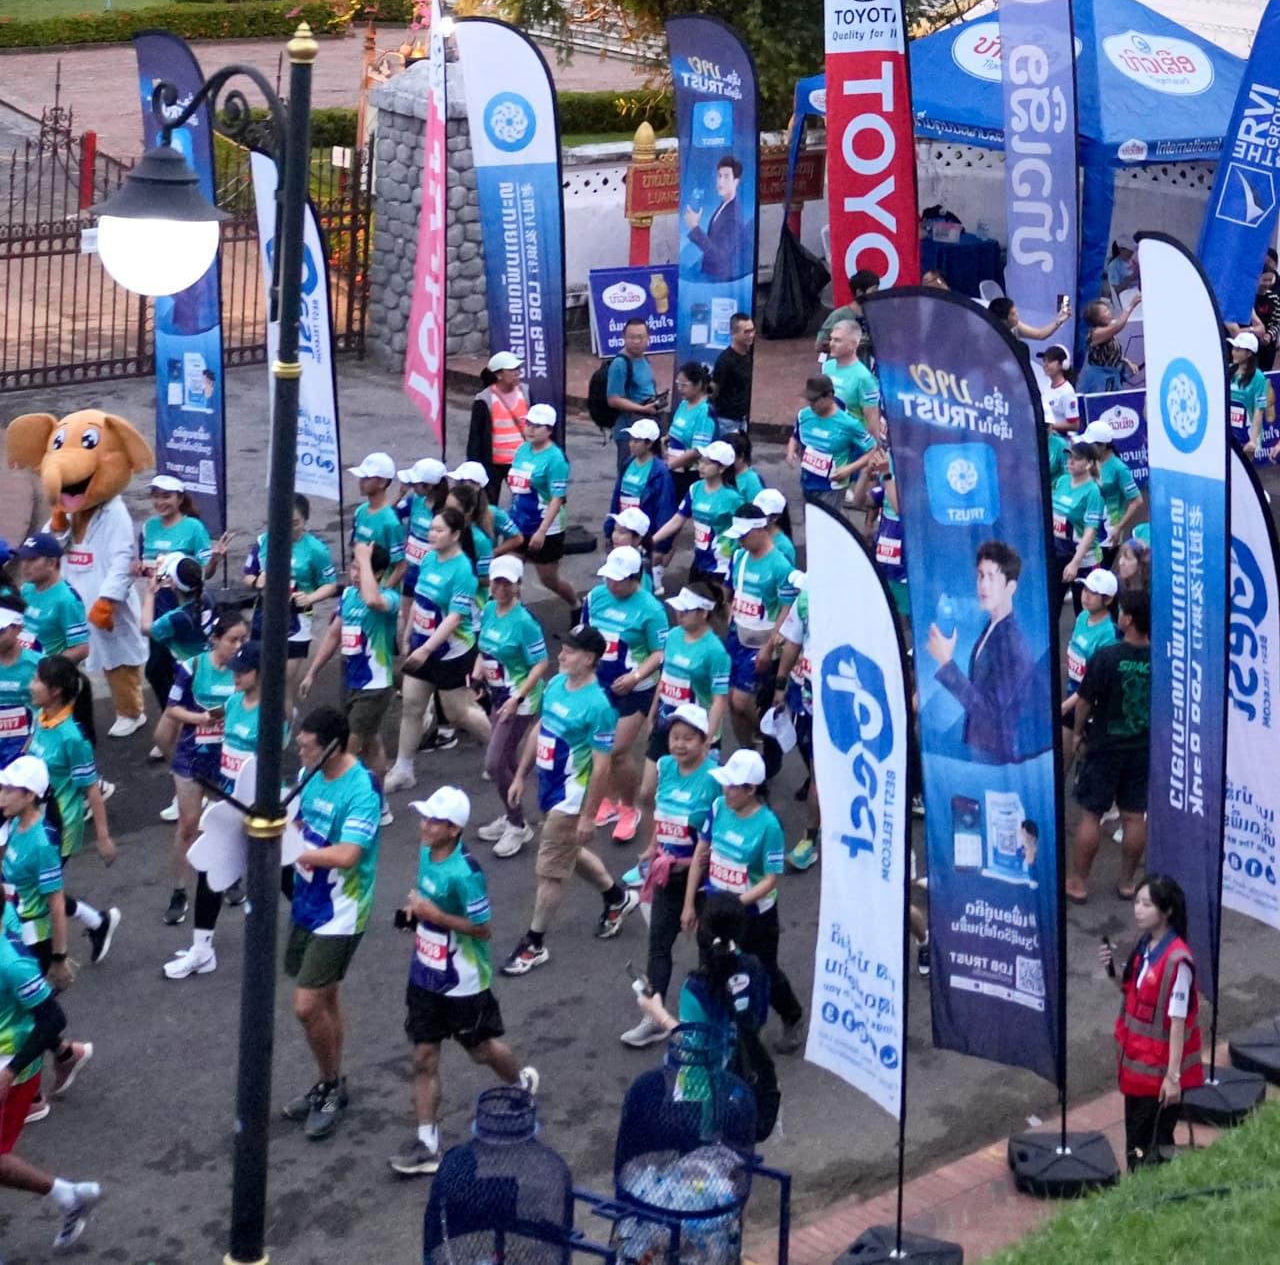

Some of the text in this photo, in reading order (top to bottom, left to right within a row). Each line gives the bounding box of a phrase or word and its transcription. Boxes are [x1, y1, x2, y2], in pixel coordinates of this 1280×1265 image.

[832, 30, 865, 42] Quality
[870, 28, 884, 39] for
[1239, 83, 1280, 142] RVI
[841, 61, 900, 291] TOYO
